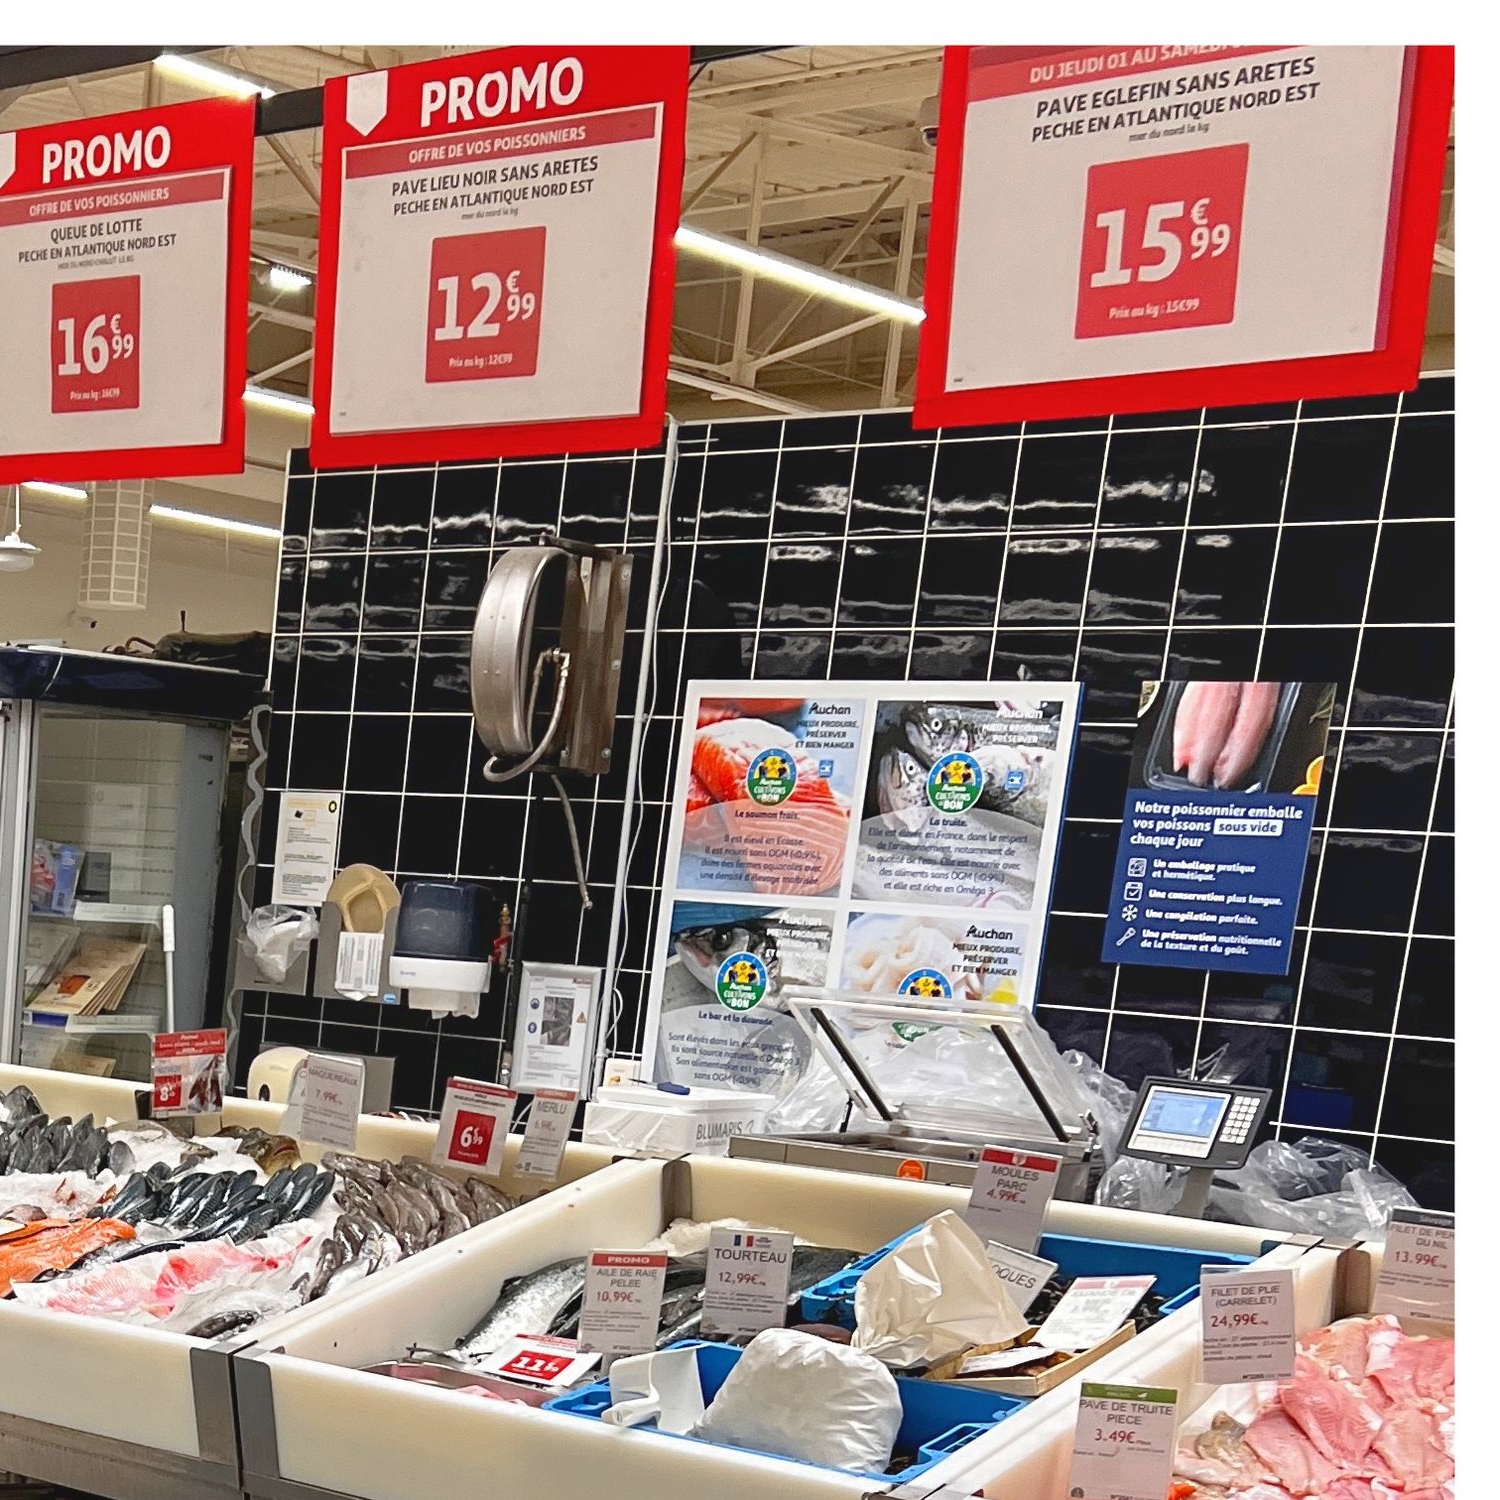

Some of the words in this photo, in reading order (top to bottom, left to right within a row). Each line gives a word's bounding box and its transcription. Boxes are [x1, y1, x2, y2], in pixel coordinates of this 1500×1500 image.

[1030, 66, 1054, 84] DU
[1056, 57, 1105, 80] JEUDI
[1107, 55, 1127, 69] 01
[1131, 49, 1157, 65] AU
[420, 57, 584, 128] PROMO
[1036, 93, 1087, 118] PAVE
[1092, 79, 1171, 110] EGLEFIN
[1175, 70, 1230, 96] SANS
[1234, 56, 1315, 87] ARETES
[1031, 118, 1084, 143] PECHE
[1087, 115, 1110, 133] EN
[1114, 98, 1225, 129] ATLANTIQUE
[1229, 89, 1281, 112] NORD
[1285, 82, 1321, 103] EST
[409, 148, 445, 164] OFFRE
[448, 143, 465, 157] DE
[466, 139, 491, 155] VOS
[493, 126, 586, 151] POISSONNIERS
[42, 125, 171, 184] PROMO
[392, 178, 428, 196] PAVE
[430, 174, 460, 191] LIEU
[462, 169, 497, 188] NOIR
[500, 163, 539, 182] SANS
[542, 156, 599, 177] ARETES
[29, 202, 58, 217] OFFRE
[59, 200, 73, 213] DE
[74, 196, 95, 210] VOS
[96, 187, 170, 208] POISSONNIERS
[393, 199, 430, 216] PECHE
[432, 197, 448, 211] EN
[450, 187, 529, 209] ATLANTIQUE
[531, 182, 568, 200] NORD
[570, 178, 595, 194] EST
[51, 224, 87, 244] QUEUE
[90, 223, 105, 237] DE
[106, 218, 143, 235] LOTTE
[18, 249, 48, 263] PECHE
[50, 247, 62, 259] EN
[64, 239, 126, 258] ATLANTIQUE
[127, 235, 156, 250] NORD
[157, 234, 177, 247] EST
[808, 702, 851, 715] Auchan
[1134, 801, 1170, 815] Notre
[1172, 803, 1246, 818] poissonnier
[1248, 805, 1303, 819] emballe
[1133, 819, 1154, 830] vos
[1156, 818, 1211, 832] poissons
[1218, 823, 1247, 832] sous
[1250, 821, 1278, 833] vide
[1130, 834, 1175, 848] chaque
[1176, 835, 1204, 849] jour
[1217, 863, 1256, 874] pratique
[966, 925, 1013, 940] Auchan
[963, 954, 1008, 965] PRÉSERVER
[537, 1101, 568, 1115] MERLU
[696, 1122, 742, 1140] BLUMARIS
[991, 1166, 1039, 1181] MOULES
[997, 1179, 1028, 1192] PARC
[1416, 1238, 1430, 1246] DU
[1432, 1239, 1448, 1249] NIL
[608, 1256, 650, 1264] PROMO
[714, 1248, 787, 1263] TOURTEAU
[610, 1279, 641, 1288] PELEE
[1212, 1288, 1238, 1297] FILET
[1241, 1287, 1255, 1295] DE
[1258, 1285, 1280, 1294] PLIE
[1215, 1296, 1277, 1308] (CARRELET)
[1210, 1313, 1259, 1328] 24,99€
[1080, 1400, 1108, 1411] PAVE
[1111, 1402, 1127, 1412] DE
[1131, 1403, 1173, 1415] TRUITE
[1107, 1413, 1142, 1425] PIECE
